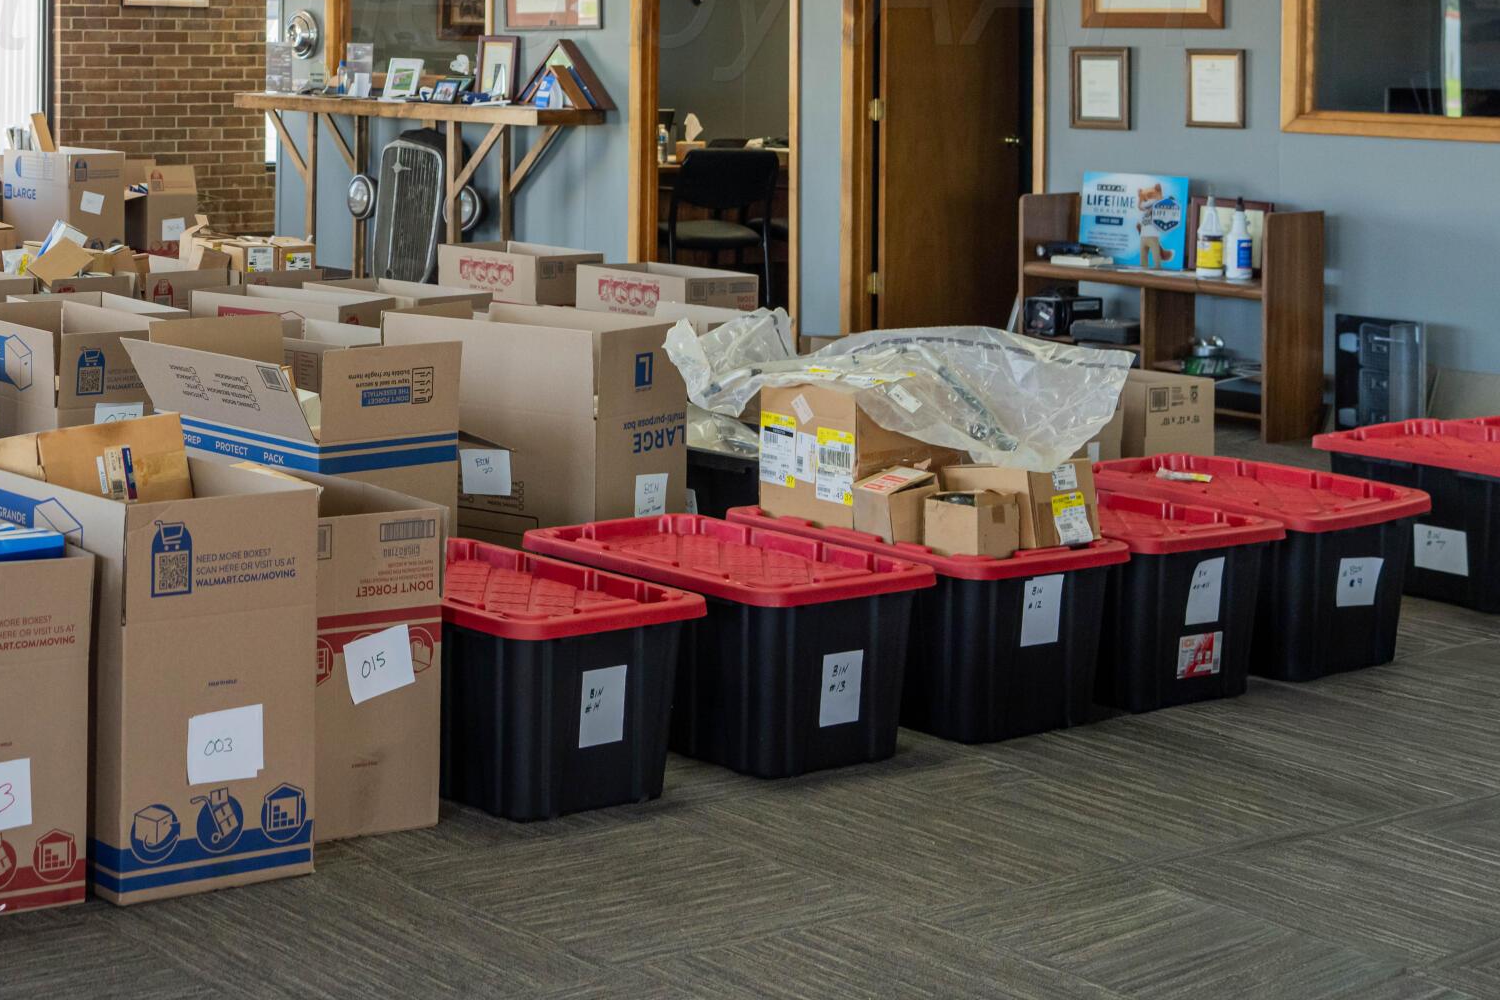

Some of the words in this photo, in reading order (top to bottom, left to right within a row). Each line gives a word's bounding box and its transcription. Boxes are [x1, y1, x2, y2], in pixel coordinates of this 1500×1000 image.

[12, 187, 36, 200] LARGE
[1086, 194, 1137, 209] LIFETIME
[623, 420, 636, 431] box
[637, 412, 685, 429] multi-purpose
[633, 424, 685, 453] LARGE
[183, 433, 202, 445] PREP
[215, 441, 248, 456] PROTECT
[263, 452, 284, 464] PACK
[196, 554, 217, 562] NEED
[219, 551, 241, 560] MORE
[244, 548, 271, 558] BOXES?
[196, 566, 217, 575] SCAN
[219, 564, 239, 572] HERE
[241, 562, 253, 570] OR
[255, 560, 273, 568] VISIT
[196, 569, 296, 587] WALMART.COM/MOVING
[356, 583, 398, 597] FORGET
[401, 580, 433, 593] DON'T
[21, 615, 50, 625] BOXES?
[18, 628, 31, 637] OR
[33, 627, 52, 635] VISIT
[53, 625, 64, 633] US
[66, 624, 75, 632] AT
[361, 651, 386, 679] 015
[832, 664, 849, 677] BIN
[590, 686, 604, 699] BIN
[204, 737, 233, 756] 003
